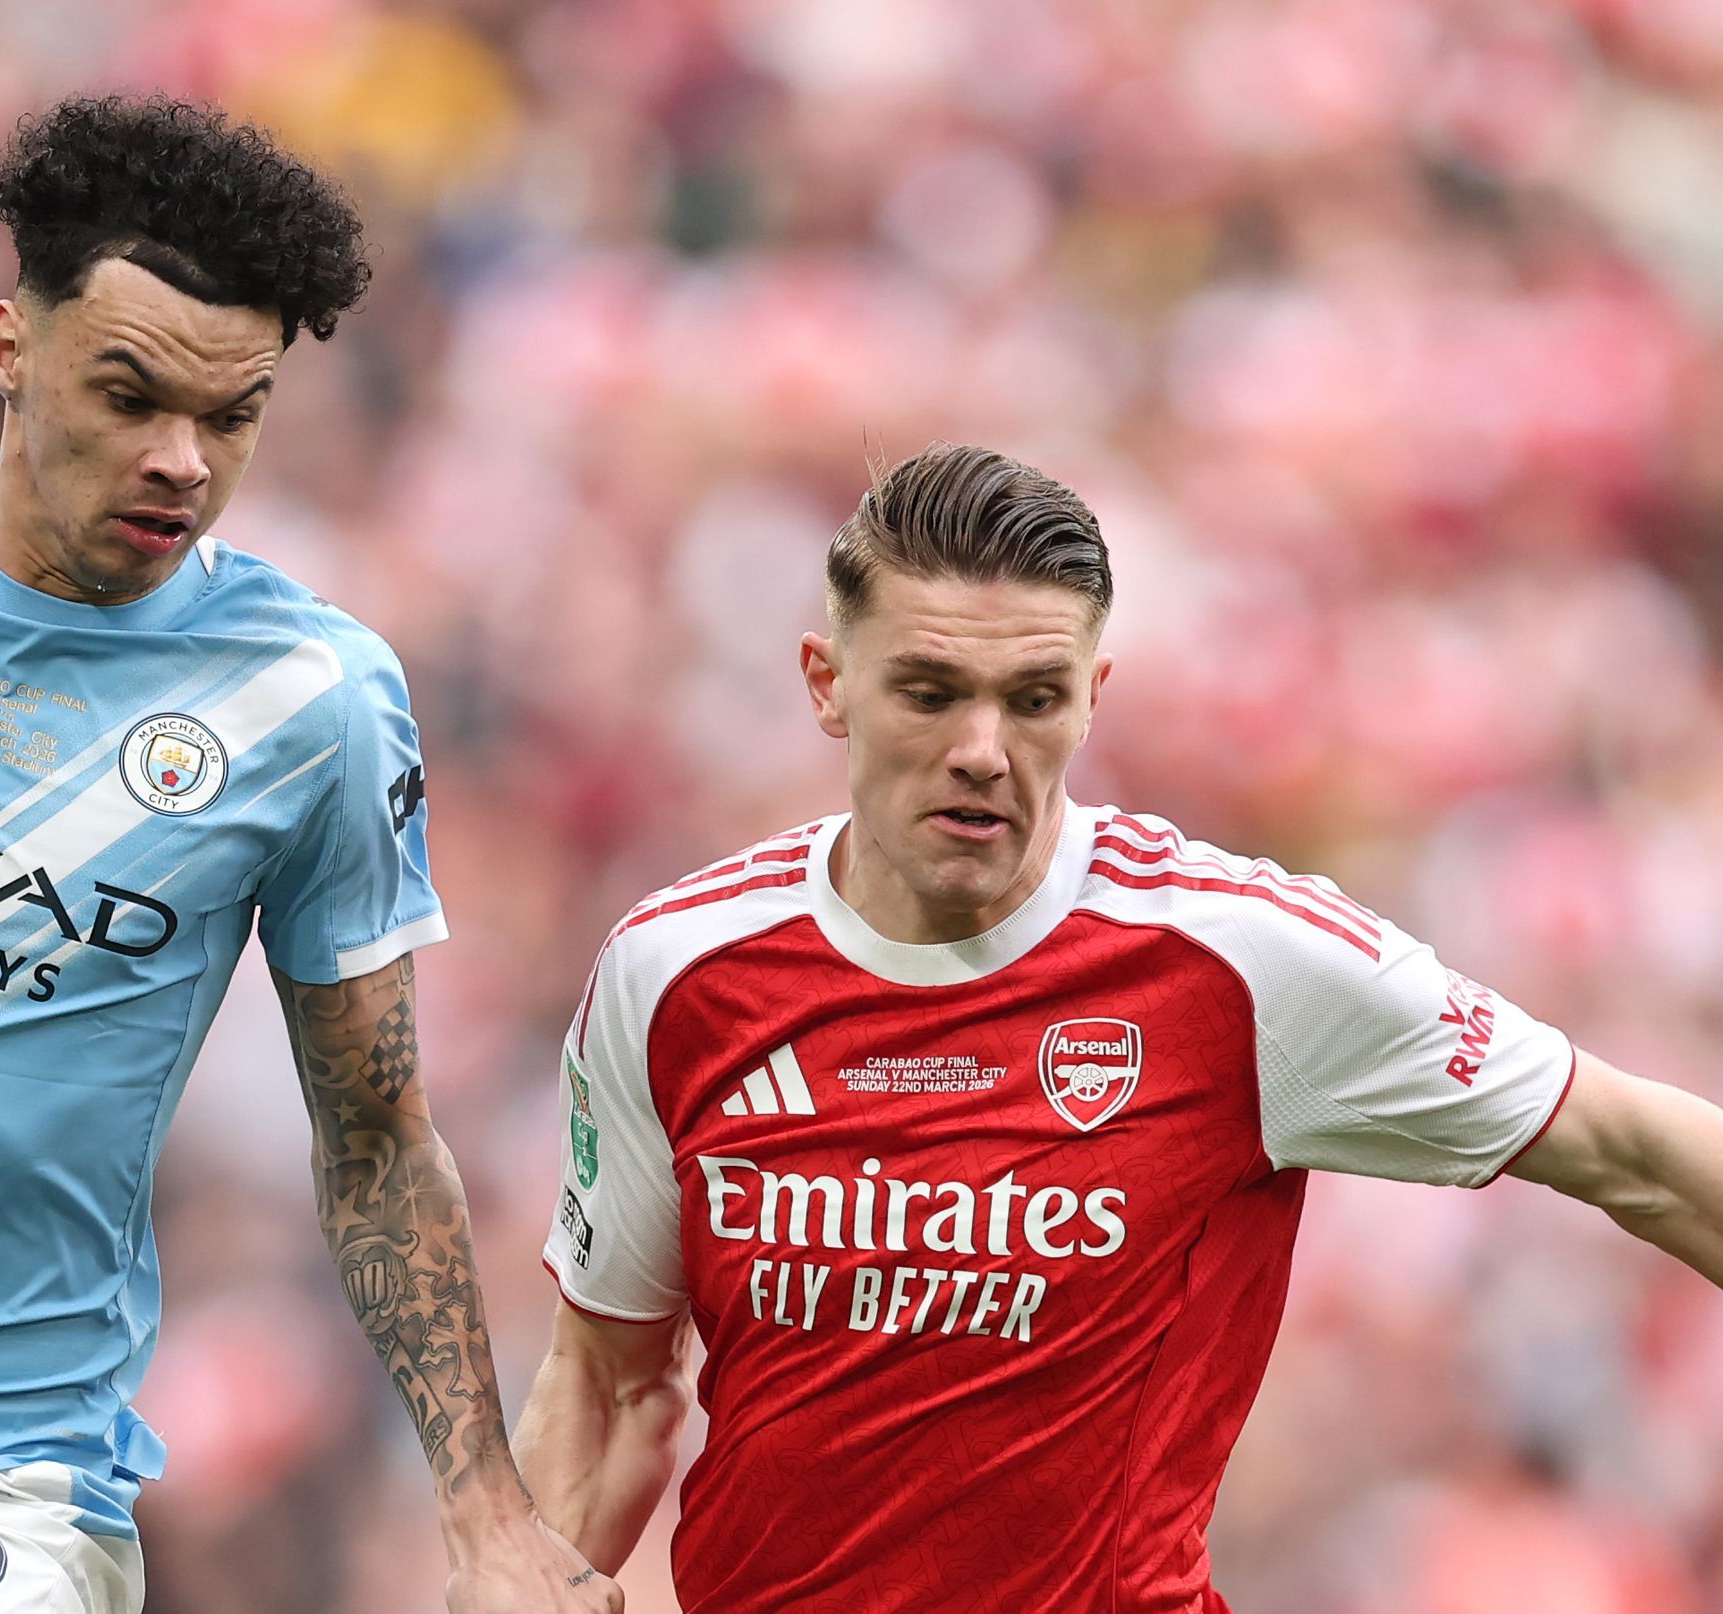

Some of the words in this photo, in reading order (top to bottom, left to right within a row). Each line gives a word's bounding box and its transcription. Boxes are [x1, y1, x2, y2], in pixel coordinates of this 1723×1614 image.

[16, 684, 46, 700] CUP
[51, 692, 88, 713] FINAL
[31, 731, 59, 750] City
[138, 721, 220, 764] MANCHESTER
[21, 744, 57, 763] 2026
[2, 751, 55, 777] Stadium
[148, 793, 179, 810] CITY
[1054, 1036, 1128, 1056] Arsenal
[866, 1056, 921, 1069] CARABAO
[923, 1056, 945, 1068] CUP
[947, 1055, 979, 1068] FINAL
[837, 1068, 889, 1081] ARSENAL
[891, 1069, 901, 1081] V
[902, 1068, 978, 1081] MANCHESTER
[981, 1066, 1007, 1079] CITY
[846, 1080, 891, 1092] SUNDAY
[891, 1081, 922, 1093] 22ND
[924, 1080, 966, 1093] MARCH
[967, 1079, 995, 1091] 2026
[696, 1155, 1126, 1258] Emirates
[750, 1258, 831, 1331] FLY
[848, 1266, 1047, 1343] BETTER
